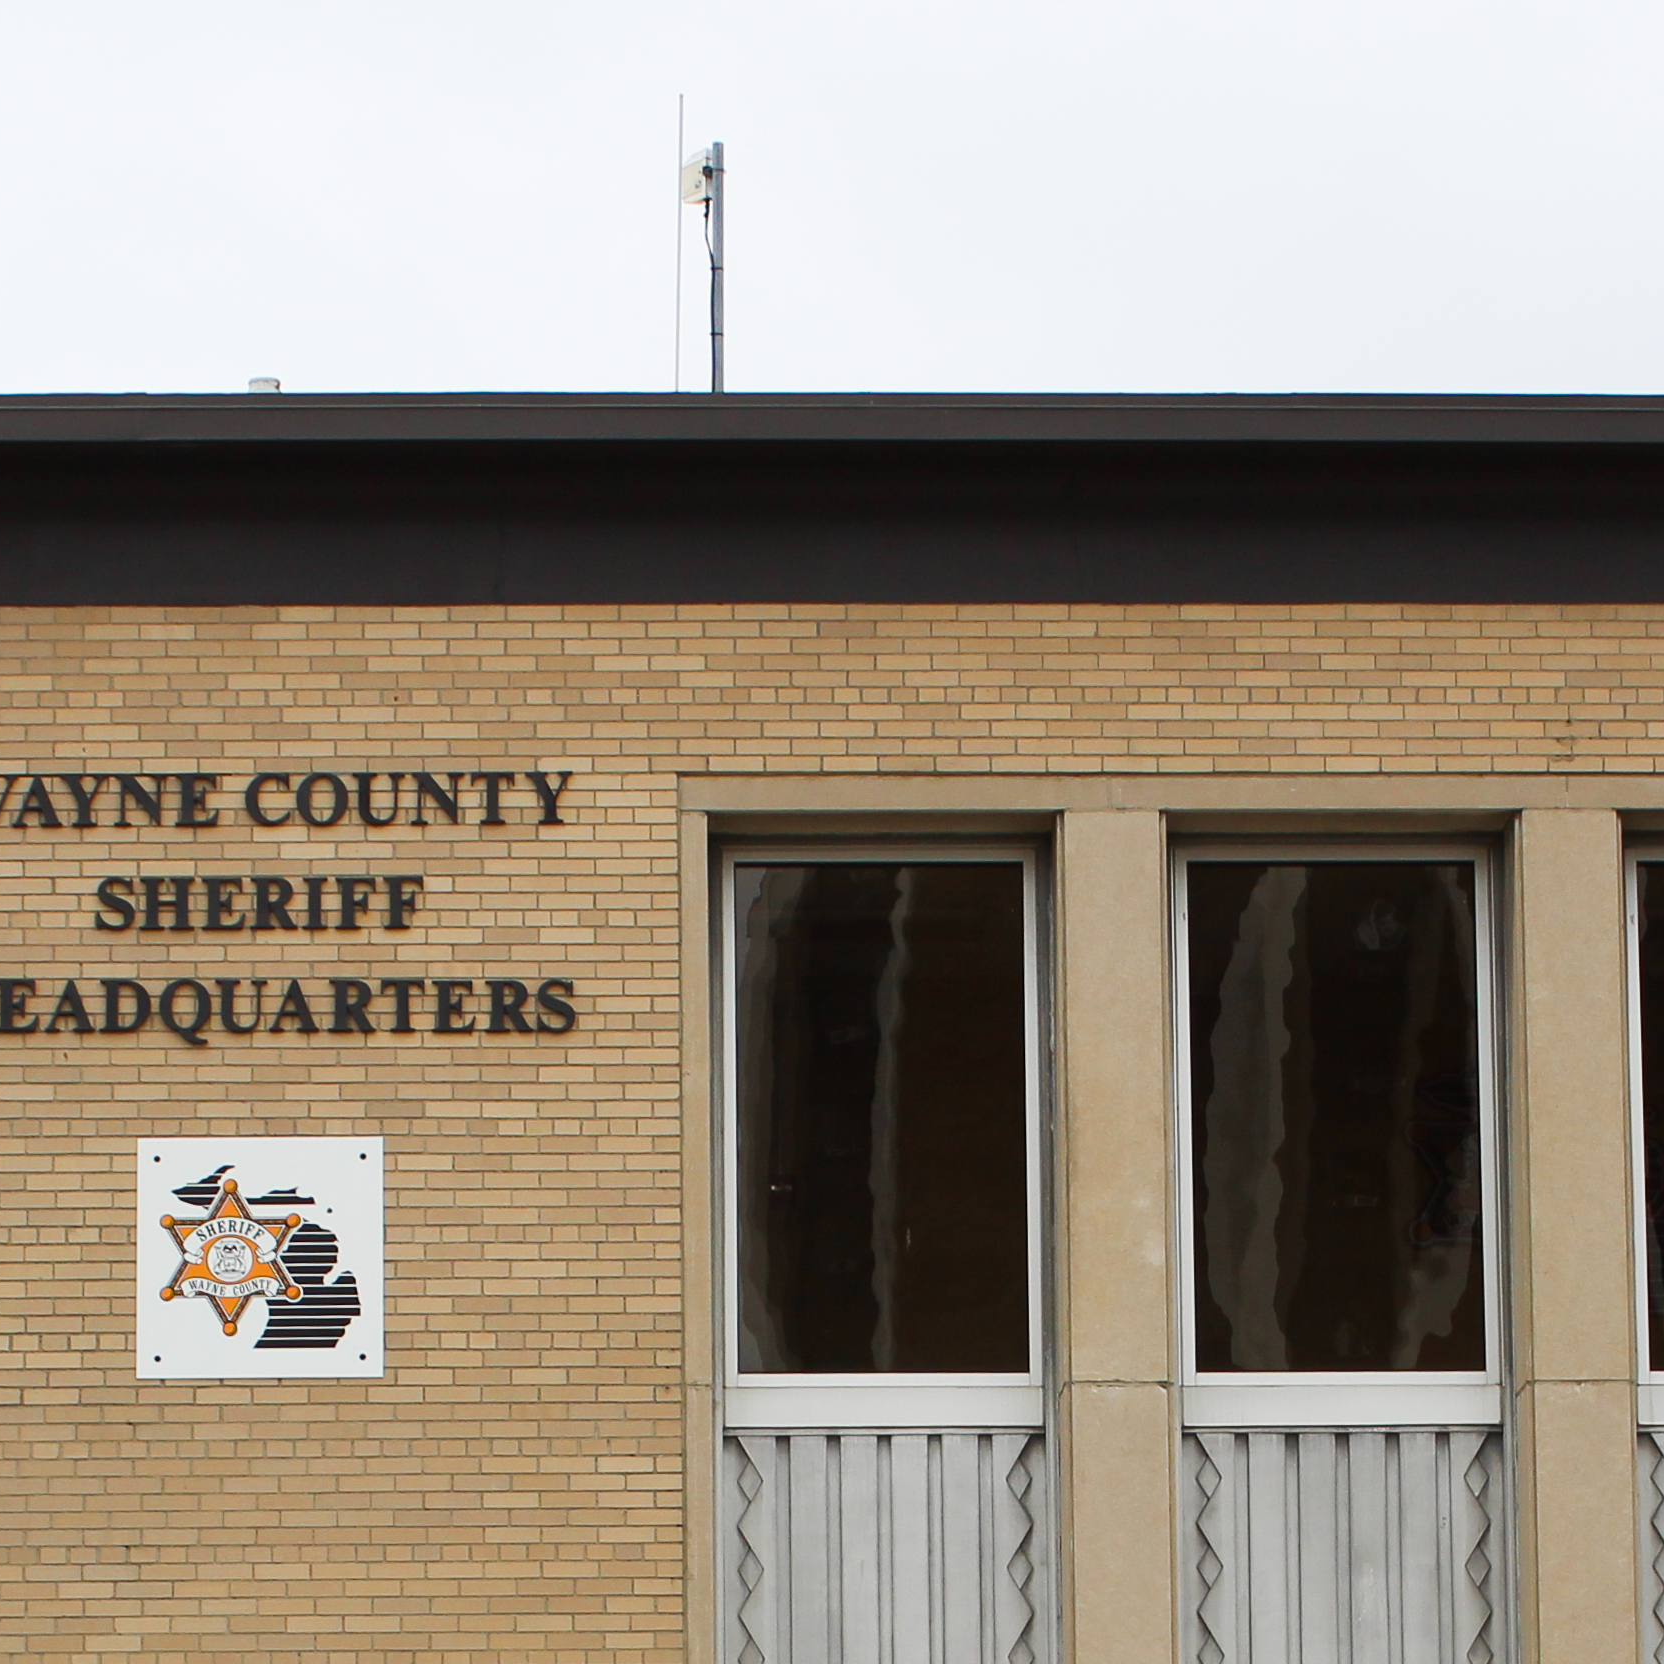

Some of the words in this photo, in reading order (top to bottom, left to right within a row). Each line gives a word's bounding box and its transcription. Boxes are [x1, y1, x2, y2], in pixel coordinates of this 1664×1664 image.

[244, 771, 574, 827] COUNTY
[94, 875, 425, 932] SHERIFF
[196, 1218, 266, 1243] SHERIFF
[188, 1279, 227, 1296] WAYNE
[232, 1279, 272, 1296] COUNTY
